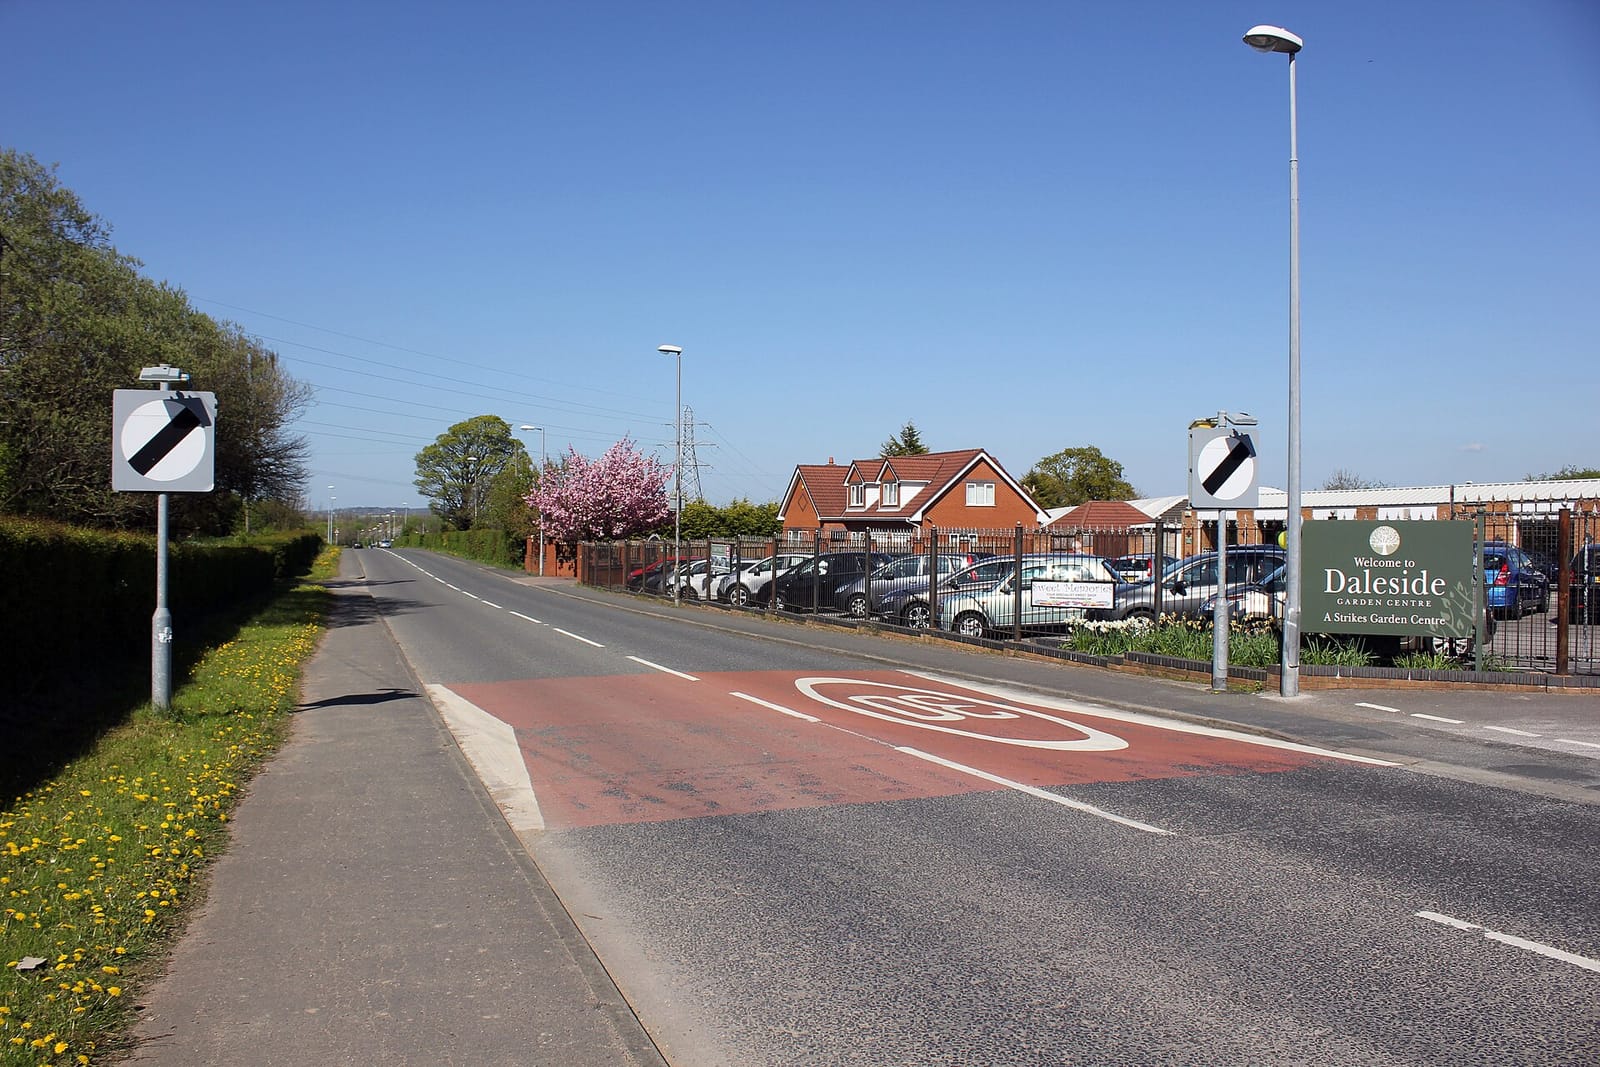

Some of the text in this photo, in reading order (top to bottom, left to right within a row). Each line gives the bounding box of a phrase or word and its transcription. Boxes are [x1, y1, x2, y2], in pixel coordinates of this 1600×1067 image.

[1354, 557, 1415, 568] Welcome to
[1032, 583, 1112, 593] Sweet Memories
[1324, 568, 1446, 596] Daleside
[1337, 598, 1432, 607] GARDEN CENTRE
[1324, 612, 1446, 625] A Strikes Garden Centre
[848, 694, 1020, 721] 30
